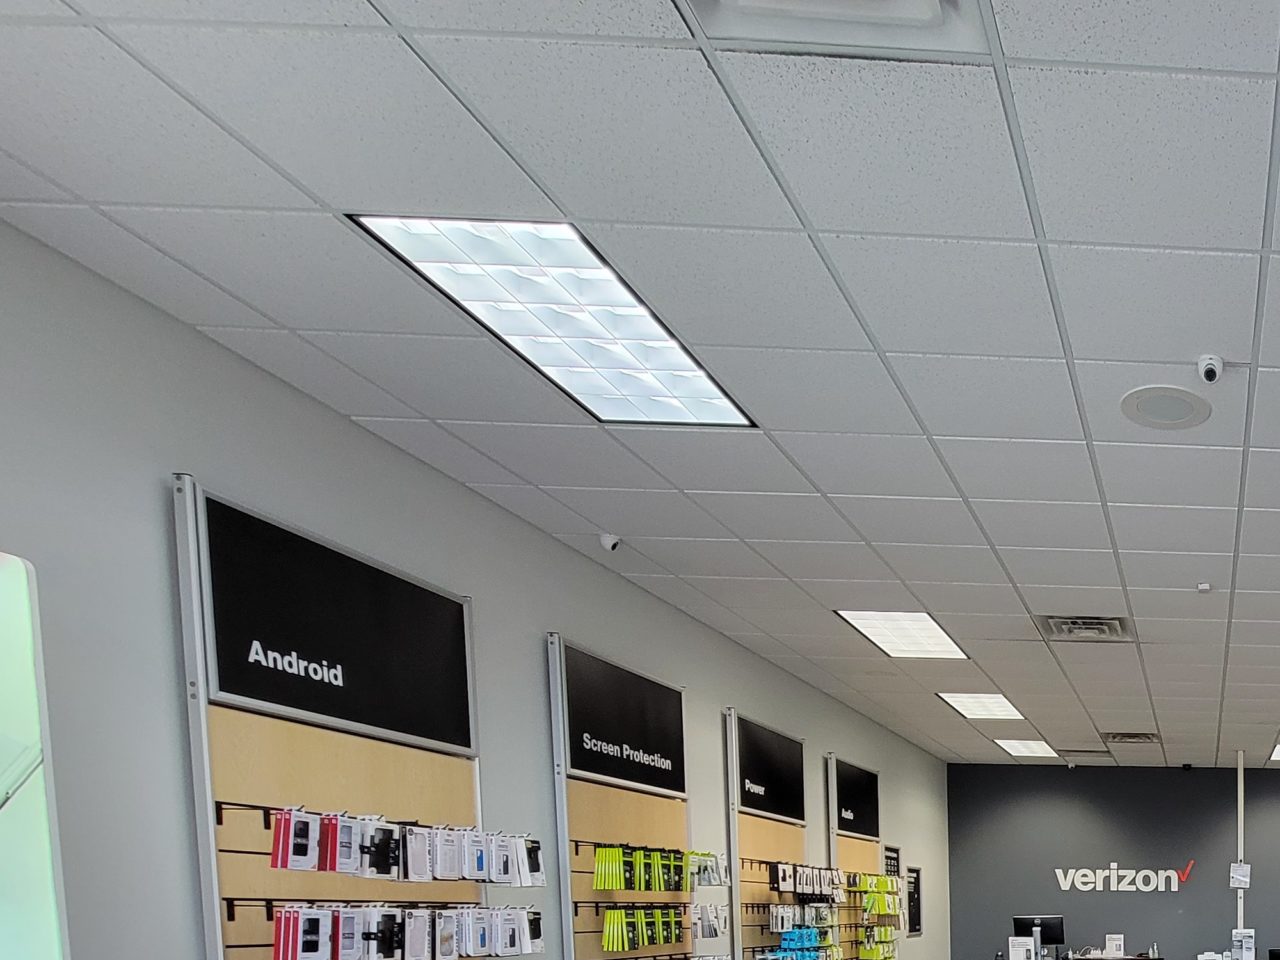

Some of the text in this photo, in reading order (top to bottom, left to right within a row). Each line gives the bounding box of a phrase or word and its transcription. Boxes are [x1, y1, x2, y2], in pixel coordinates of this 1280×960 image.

[247, 639, 345, 687] Android
[582, 732, 673, 771] Screen Protection
[744, 778, 765, 796] Power
[1055, 862, 1180, 892] verizon
